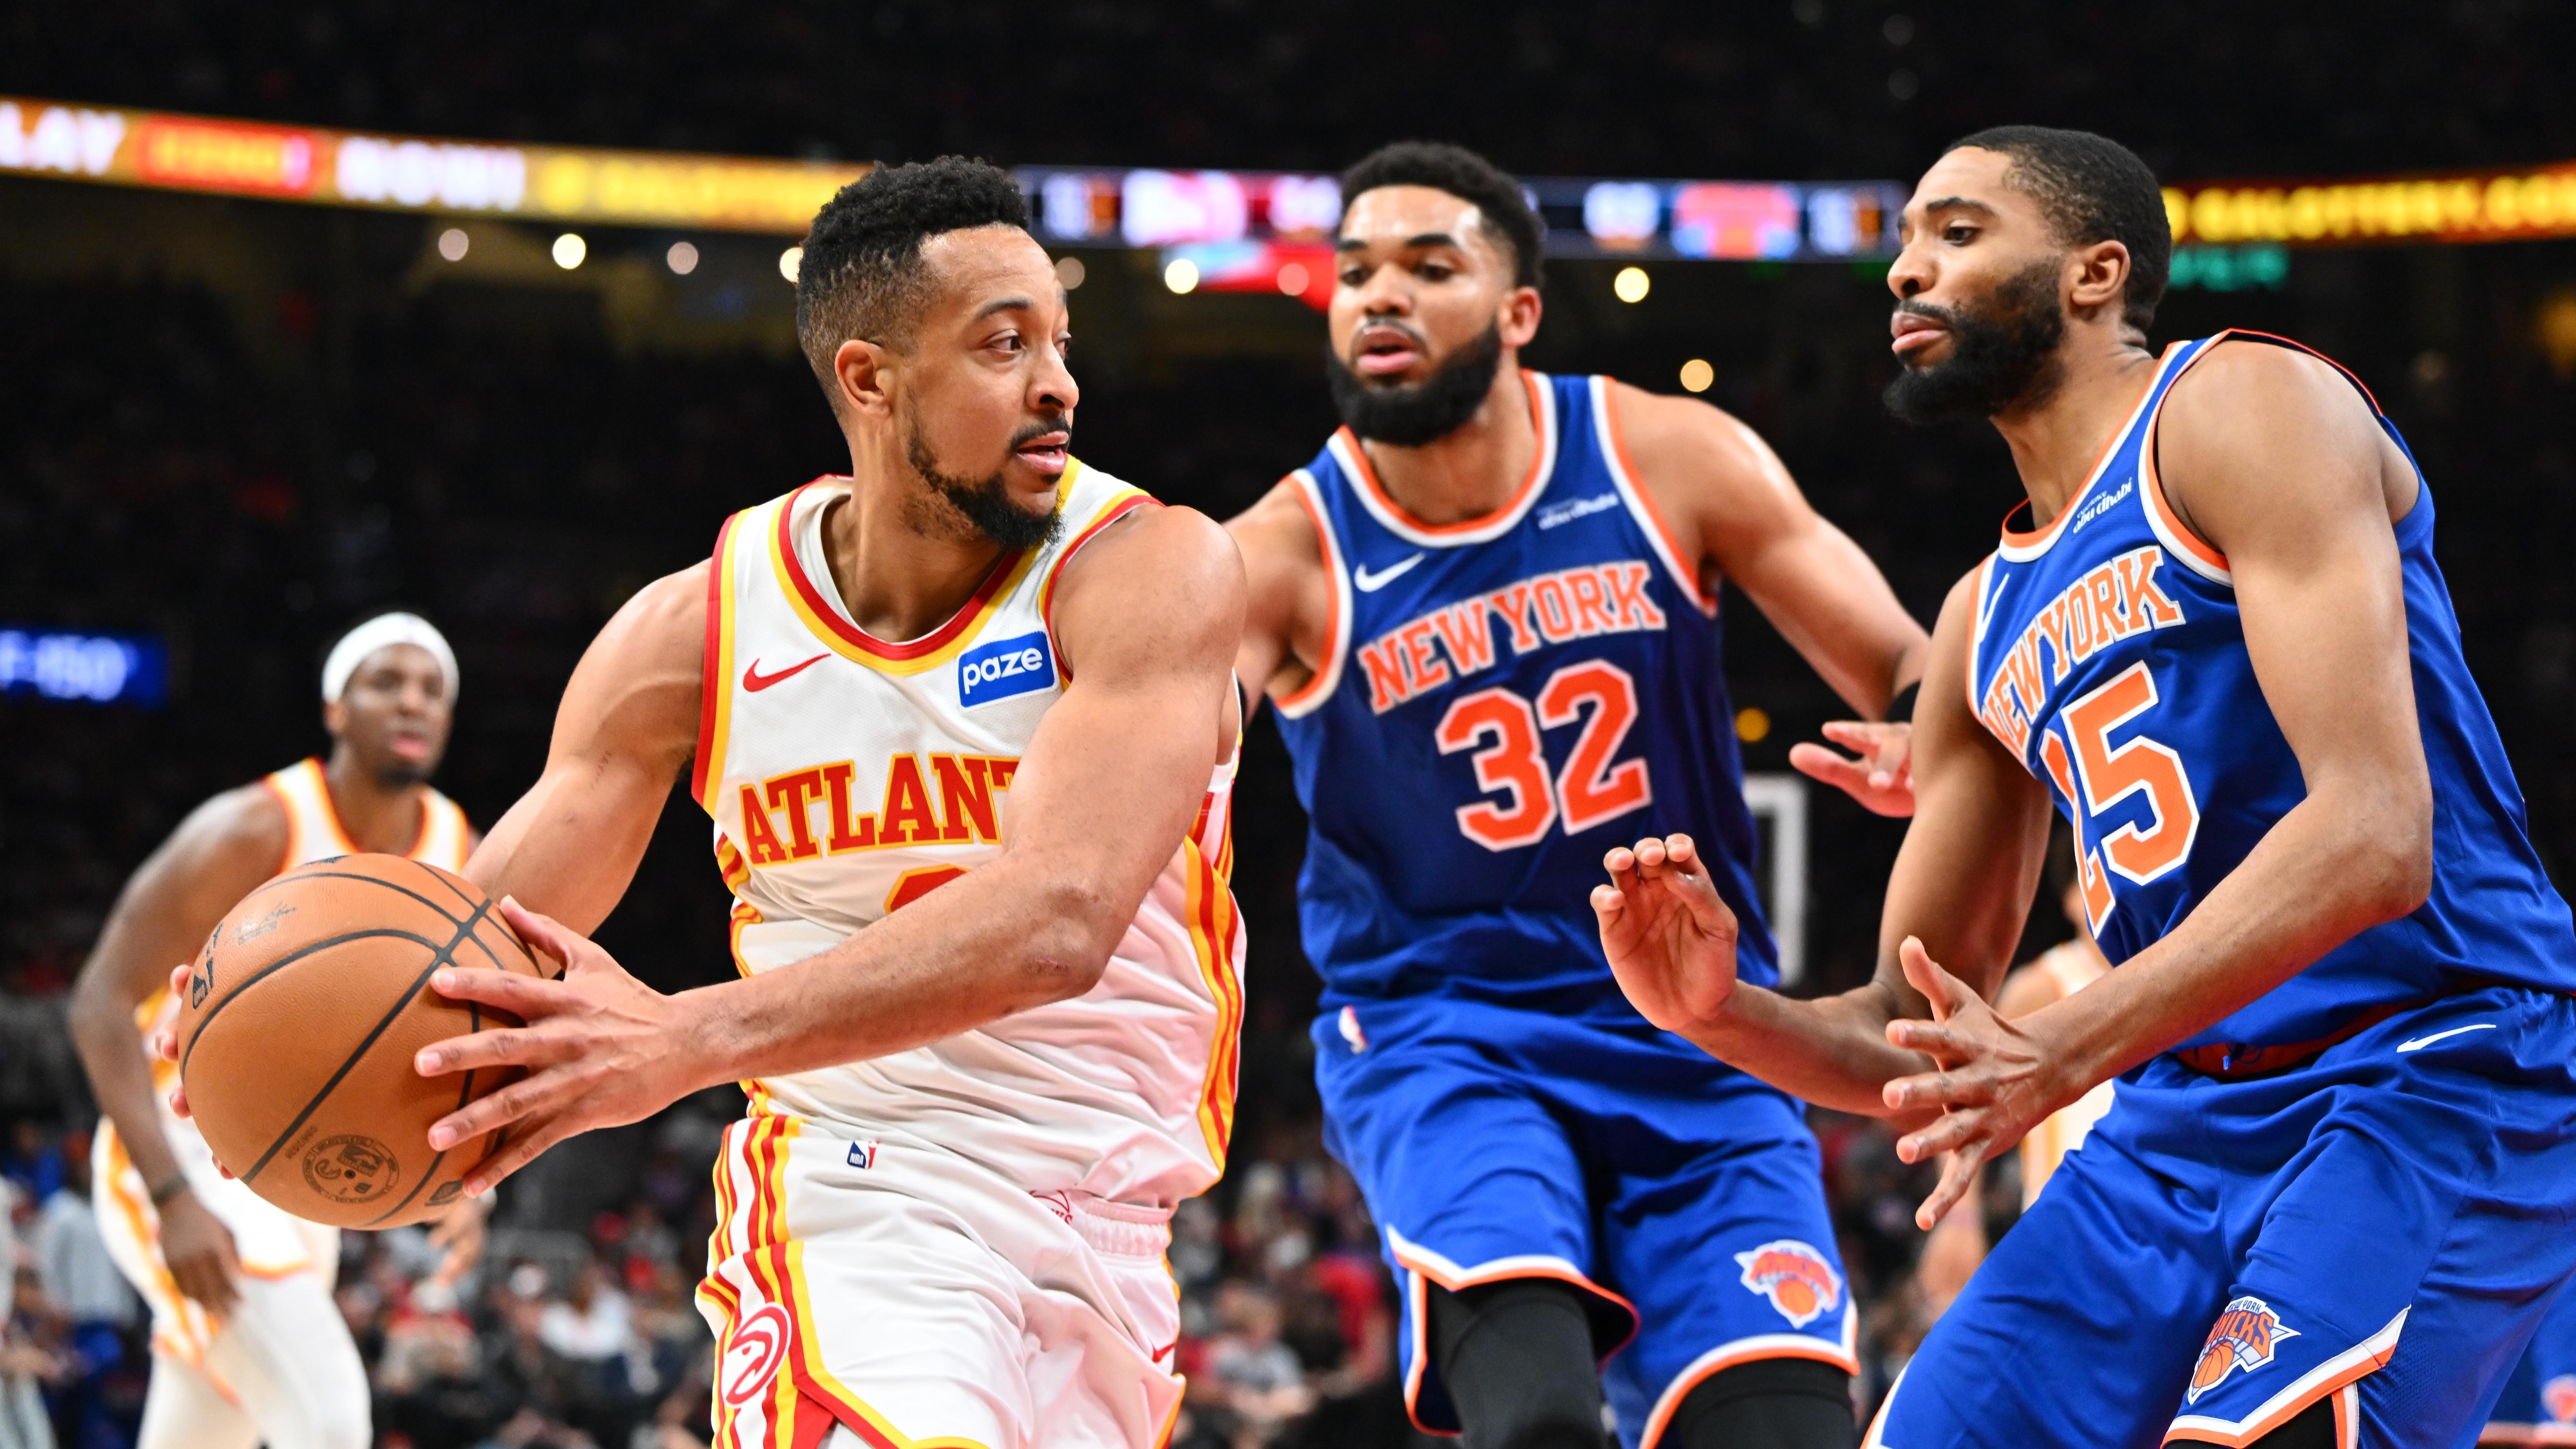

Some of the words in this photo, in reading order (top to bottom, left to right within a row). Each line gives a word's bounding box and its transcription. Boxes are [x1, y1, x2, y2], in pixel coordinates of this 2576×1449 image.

[962, 647, 1043, 695] paze
[1357, 599, 1495, 715] NEW
[1490, 559, 1668, 655] YORK
[1981, 617, 2046, 771] NEW
[2035, 544, 2187, 687] YORK
[739, 752, 1021, 868] ATLAN
[1434, 658, 1653, 854] 32
[2243, 1299, 2262, 1314] YORK
